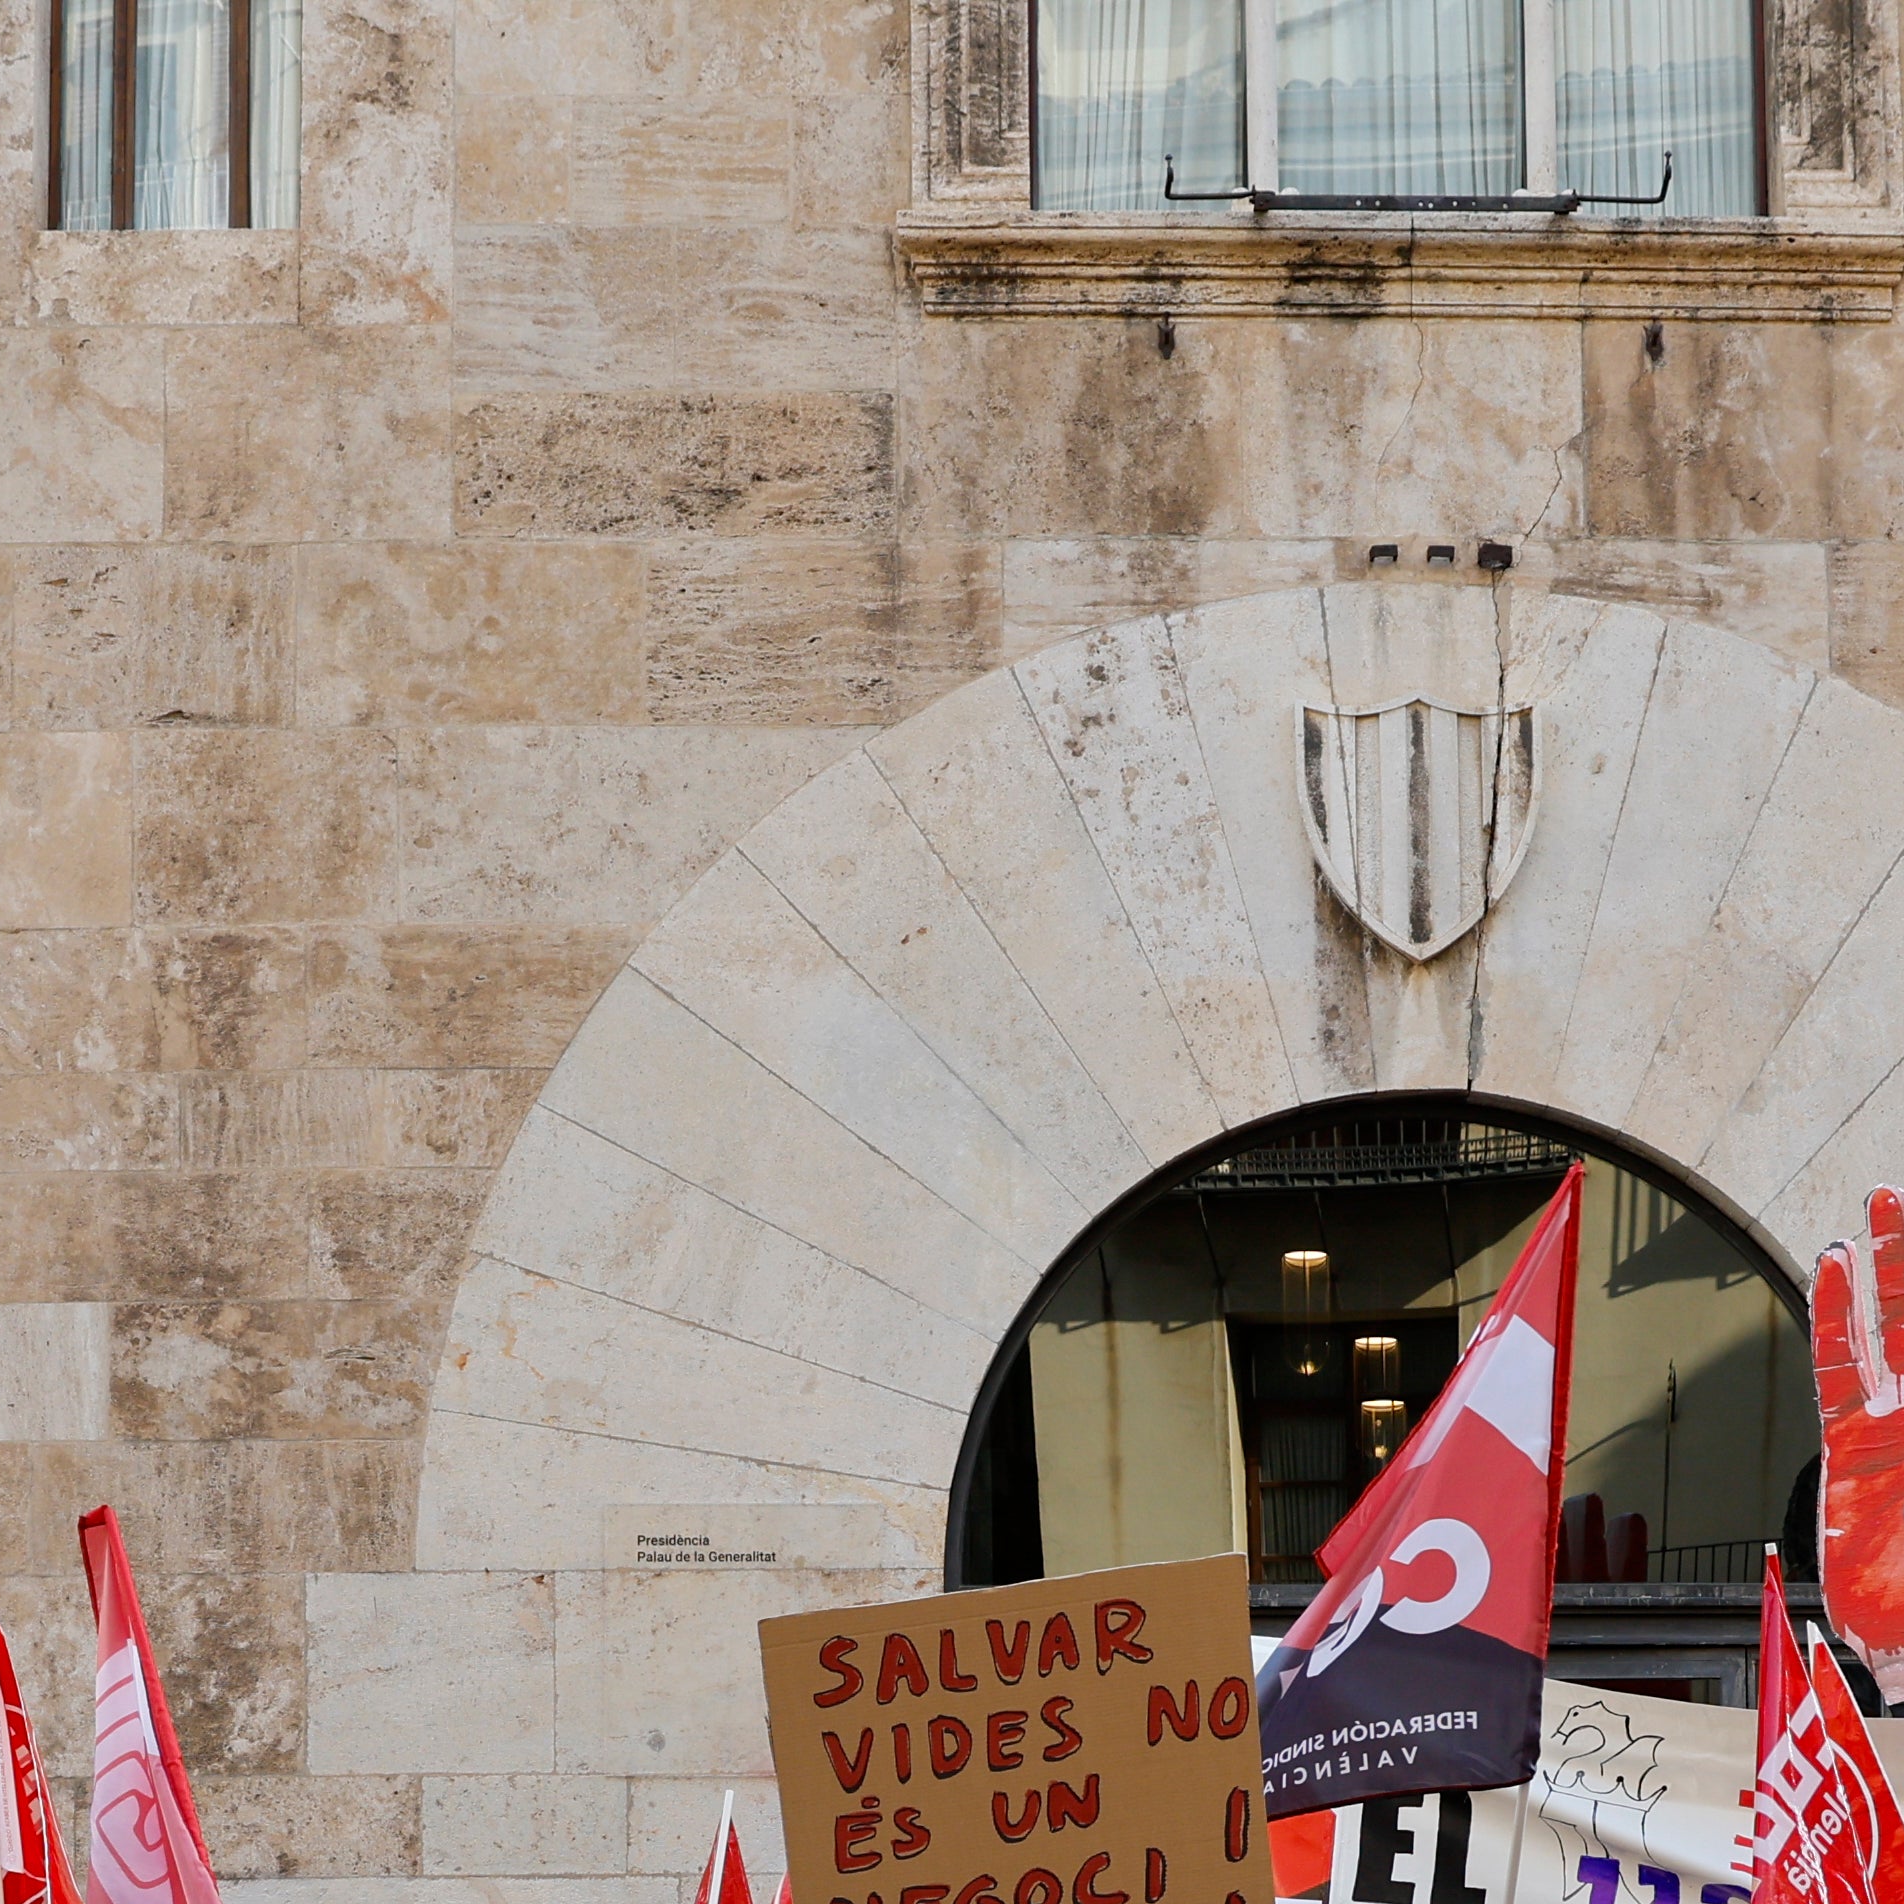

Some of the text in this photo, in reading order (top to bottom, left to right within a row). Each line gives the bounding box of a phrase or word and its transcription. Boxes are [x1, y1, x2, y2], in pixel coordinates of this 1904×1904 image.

[637, 1534, 710, 1546] Presidència
[637, 1551, 776, 1562] Palau de la Generalitat
[814, 1599, 1153, 1708] SALVAR
[822, 1676, 1250, 1793] VIDES NO
[992, 1772, 1101, 1842] UN
